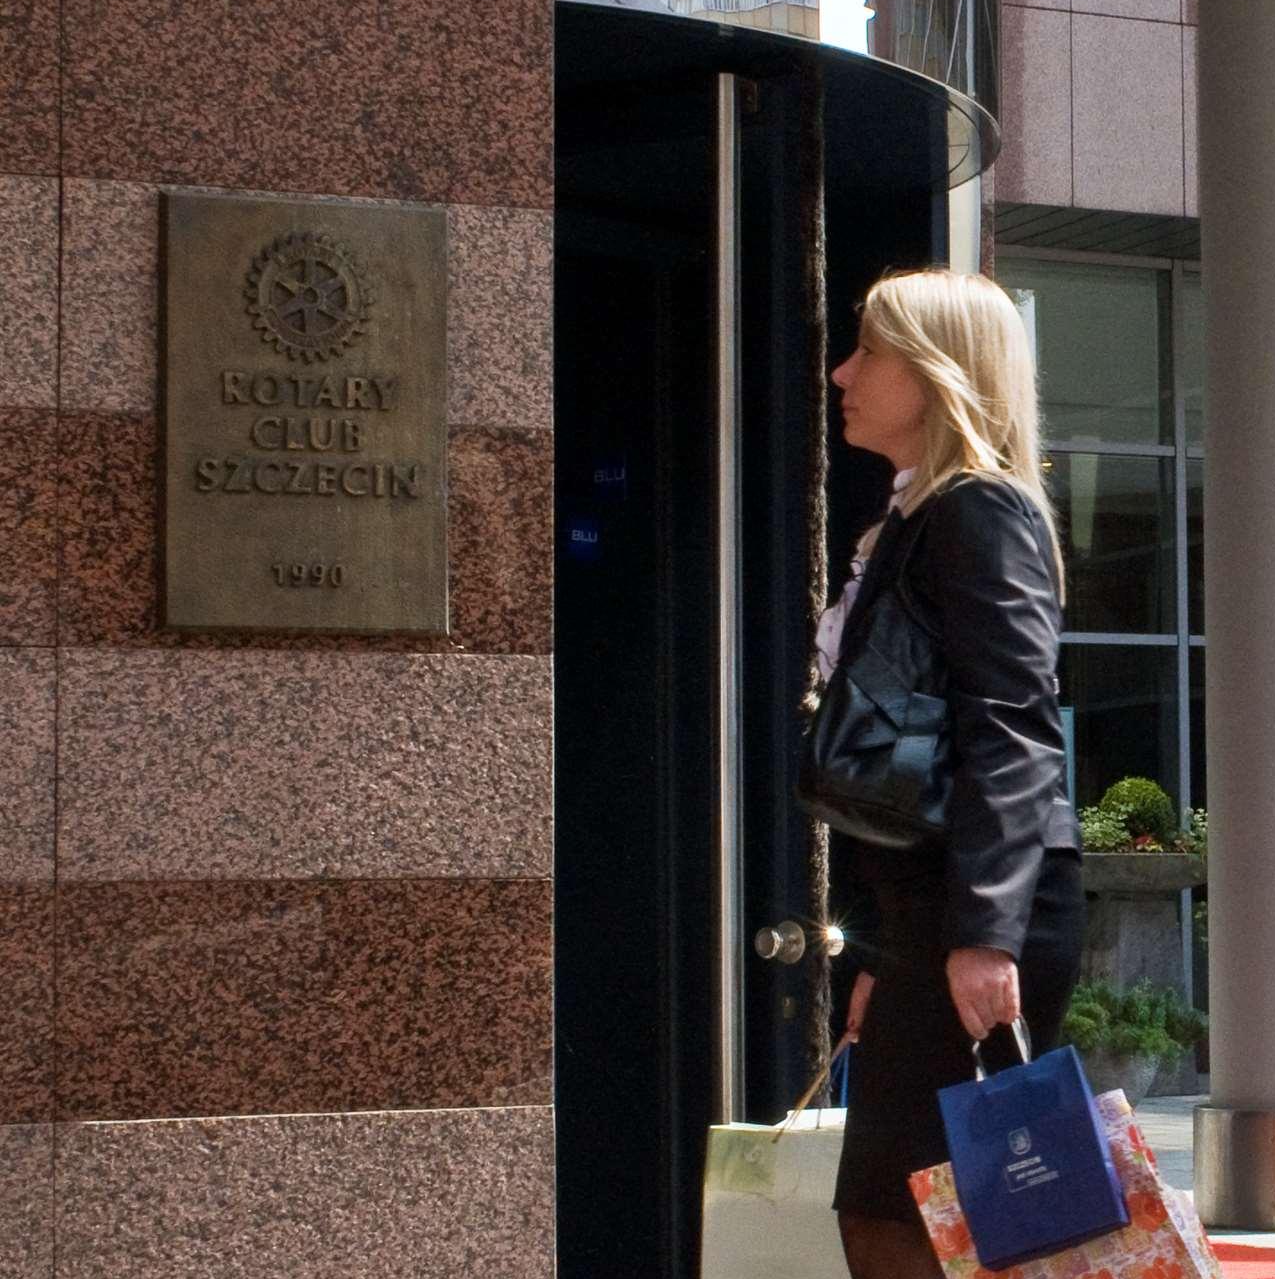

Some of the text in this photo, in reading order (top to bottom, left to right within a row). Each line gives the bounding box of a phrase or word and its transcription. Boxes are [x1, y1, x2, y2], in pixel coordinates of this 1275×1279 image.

[222, 370, 398, 410] ROTARY
[252, 416, 363, 451] CLUB
[197, 458, 418, 499] SZCZECIN
[571, 528, 598, 544] BLU
[272, 562, 347, 588] 1990
